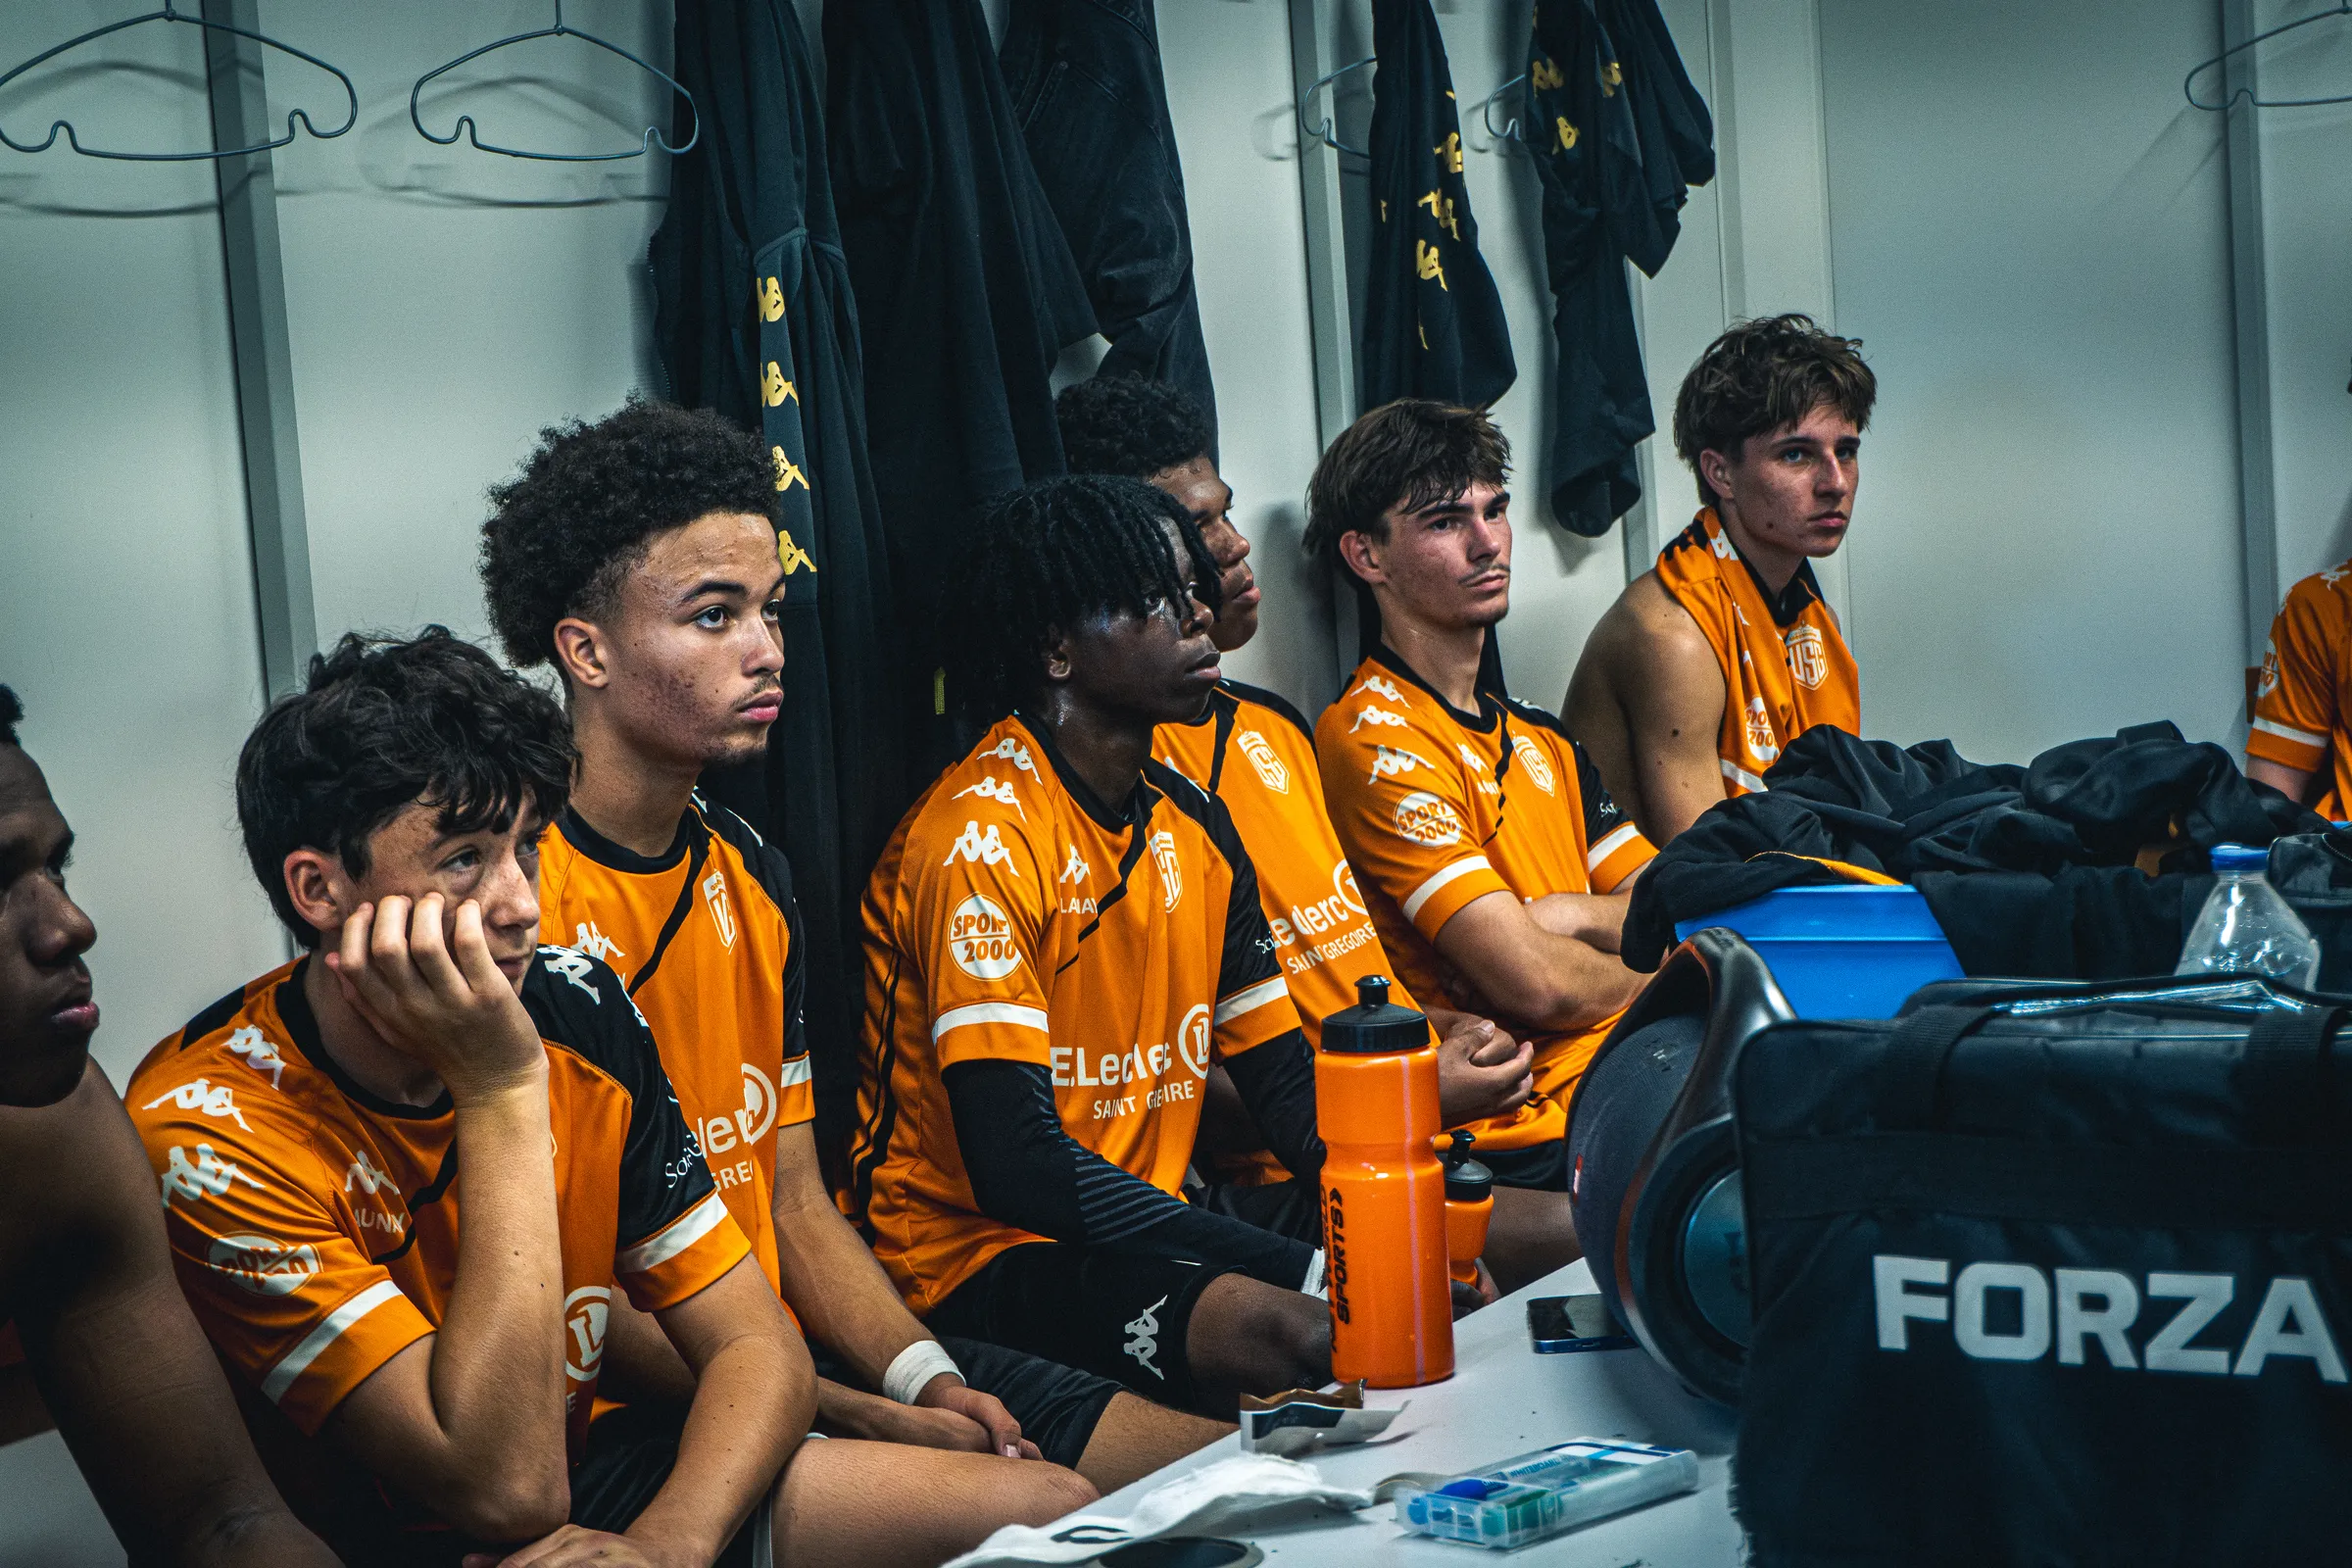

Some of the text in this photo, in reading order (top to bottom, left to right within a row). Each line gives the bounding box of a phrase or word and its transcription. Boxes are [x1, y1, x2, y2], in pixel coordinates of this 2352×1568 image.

[1748, 730, 1775, 747] 200
[963, 939, 1016, 963] 2000
[1287, 944, 1324, 974] SAIN
[1329, 1205, 1350, 1325] SPORTS
[1872, 1253, 2349, 1385] FORZA
